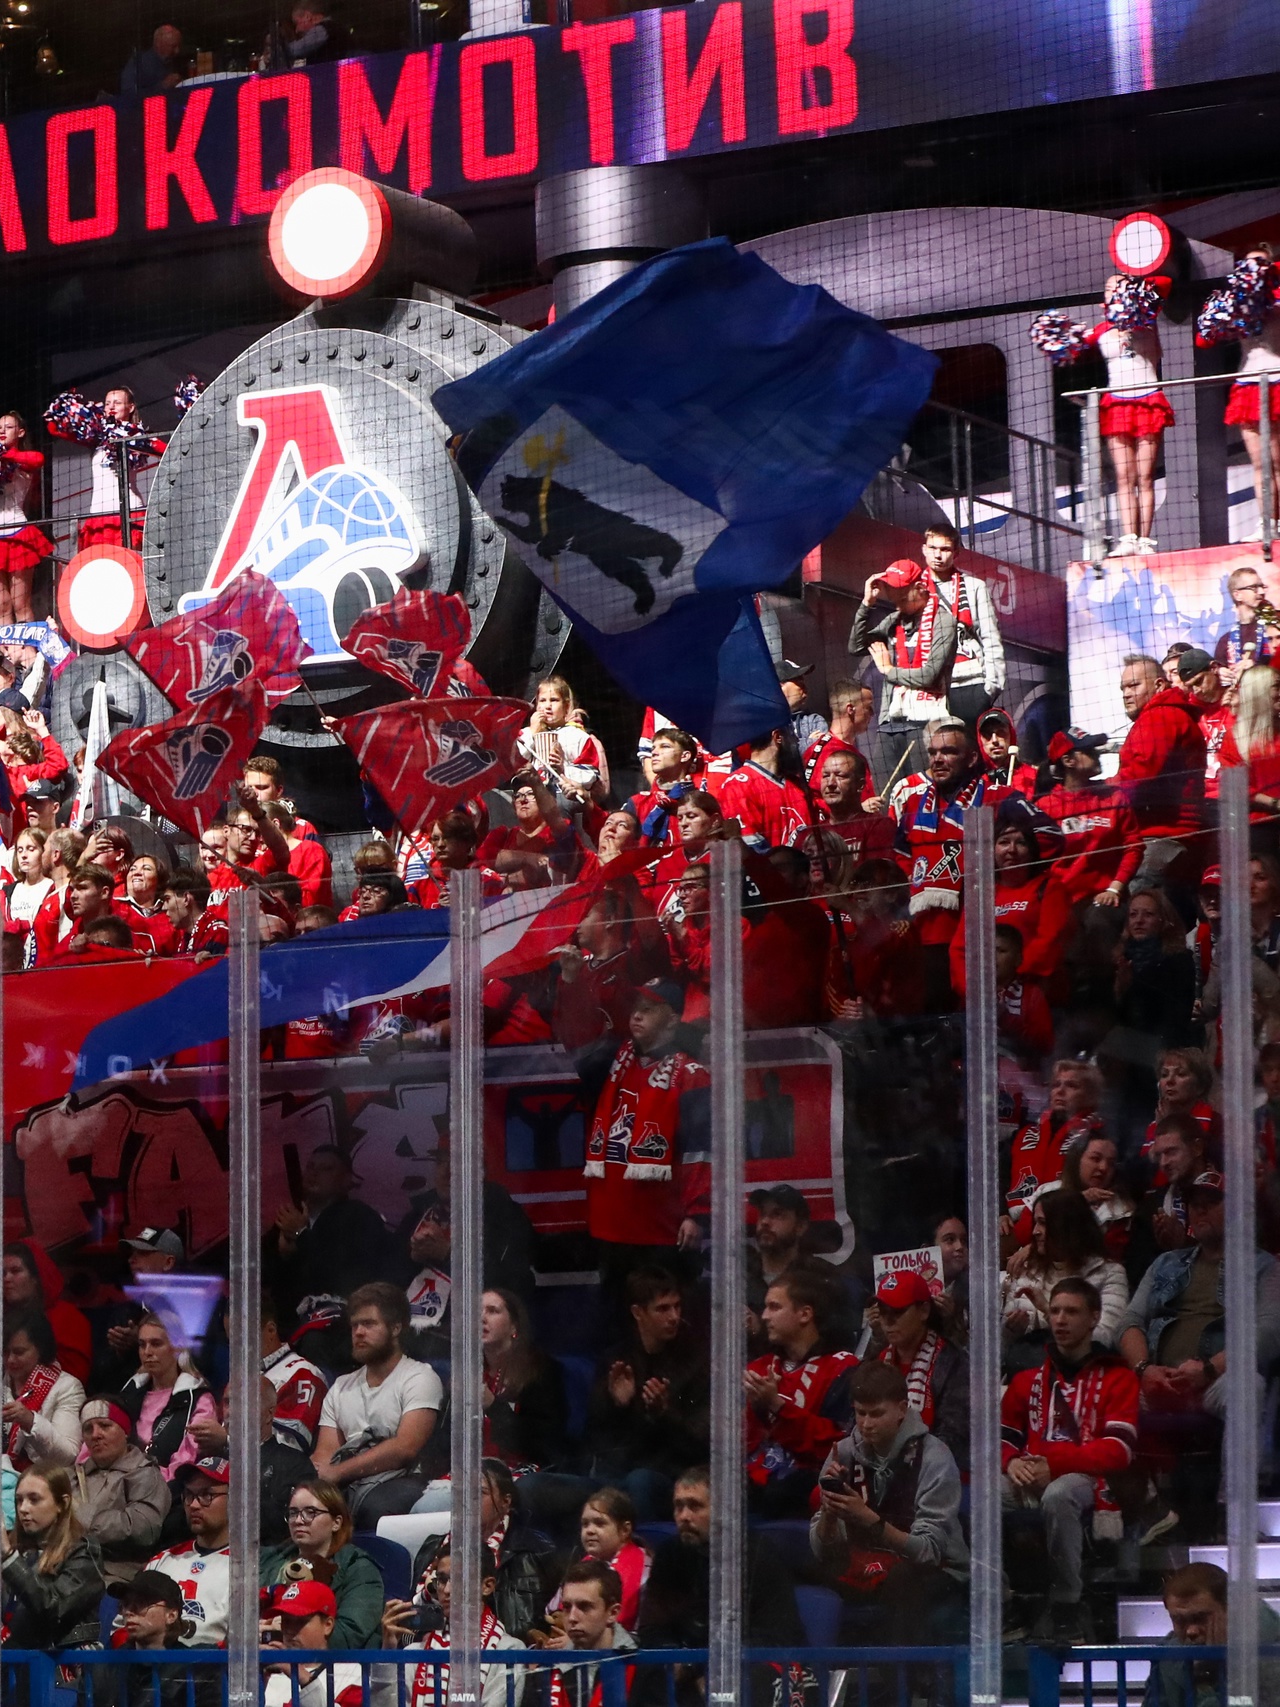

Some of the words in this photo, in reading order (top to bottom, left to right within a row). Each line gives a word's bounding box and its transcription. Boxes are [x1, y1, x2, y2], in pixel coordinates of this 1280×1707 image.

[934, 845, 961, 876] 07.09.11
[881, 1250, 931, 1270] ТОЛЬКО
[450, 1693, 476, 1702] RAITA
